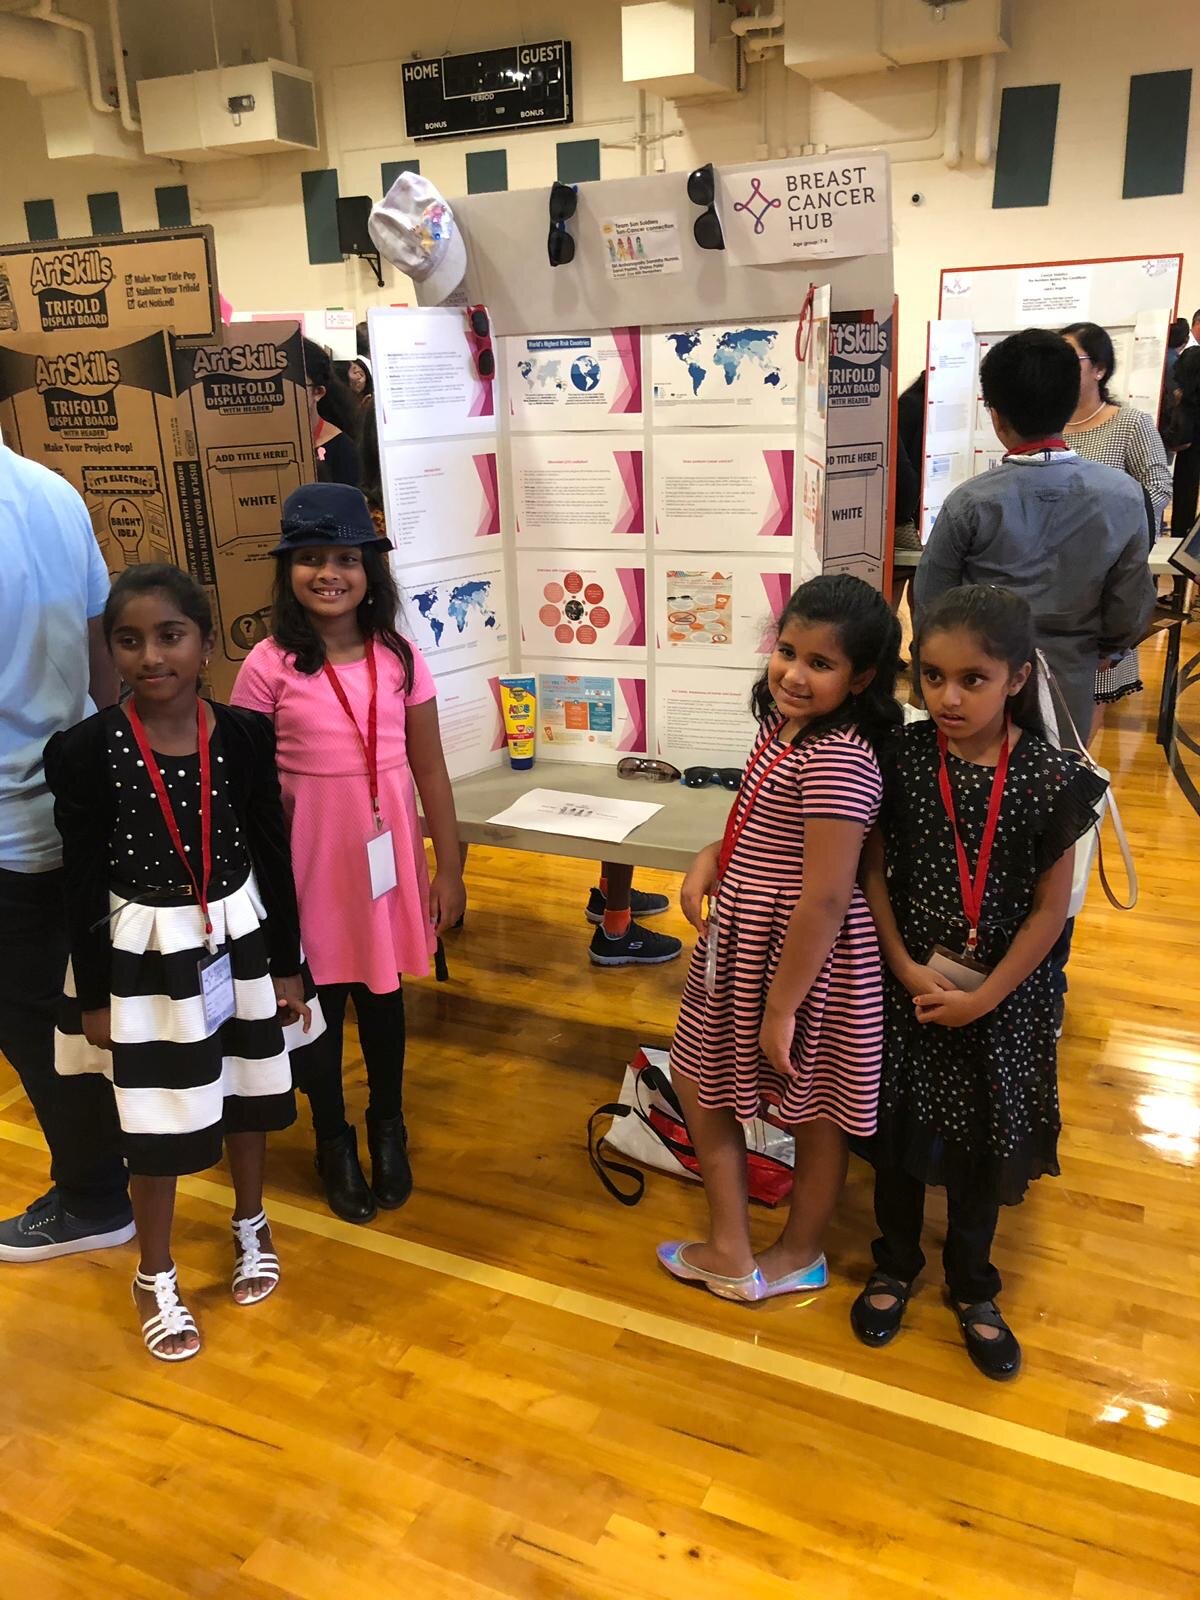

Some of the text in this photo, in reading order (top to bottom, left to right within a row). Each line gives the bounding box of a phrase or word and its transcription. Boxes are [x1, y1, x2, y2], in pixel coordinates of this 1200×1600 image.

[521, 44, 562, 64] GUEST
[404, 63, 439, 81] HOME
[470, 93, 495, 102] PERIOD
[520, 108, 544, 118] BONUS
[425, 121, 447, 130] BONUS
[786, 167, 866, 191] BREAST
[788, 187, 875, 211] CANCER
[788, 212, 833, 231] HUB
[31, 251, 113, 287] ArtSkills
[134, 271, 197, 283] Make Your Title Pop
[163, 286, 177, 294] Your
[179, 283, 200, 293] Trifold
[45, 298, 100, 316] TRIFOLD
[138, 300, 148, 308] Get
[42, 314, 107, 327] DISPLAY BOARD
[829, 321, 888, 354] rtSkills
[193, 343, 288, 372] ArtSkills
[36, 351, 121, 386] ArtSkills
[211, 381, 276, 396] TRIFOLD
[828, 383, 880, 395] SPLAY BOARD
[207, 394, 283, 406] DISPLAY BOARD
[51, 400, 108, 415] TRIFOLD
[50, 415, 117, 426] DISPLAY BOARD
[44, 442, 133, 454] Make Your Project Pop!
[216, 450, 288, 462] ADD TITLE HERE!
[837, 453, 856, 464] TITLE
[857, 452, 877, 462] HERE!
[94, 474, 147, 487] IT'S ELECTRIC
[177, 465, 187, 497] HEADER
[189, 464, 200, 496] DISPLAY
[239, 495, 277, 507] WHITE
[121, 504, 128, 513] A
[181, 499, 190, 520] WITH
[194, 498, 203, 526] BOARD
[832, 507, 863, 521] WHITE
[111, 517, 141, 526] BRIGHT
[118, 529, 138, 538] IDEA
[185, 521, 194, 549] BOARD
[198, 528, 208, 549] WITH
